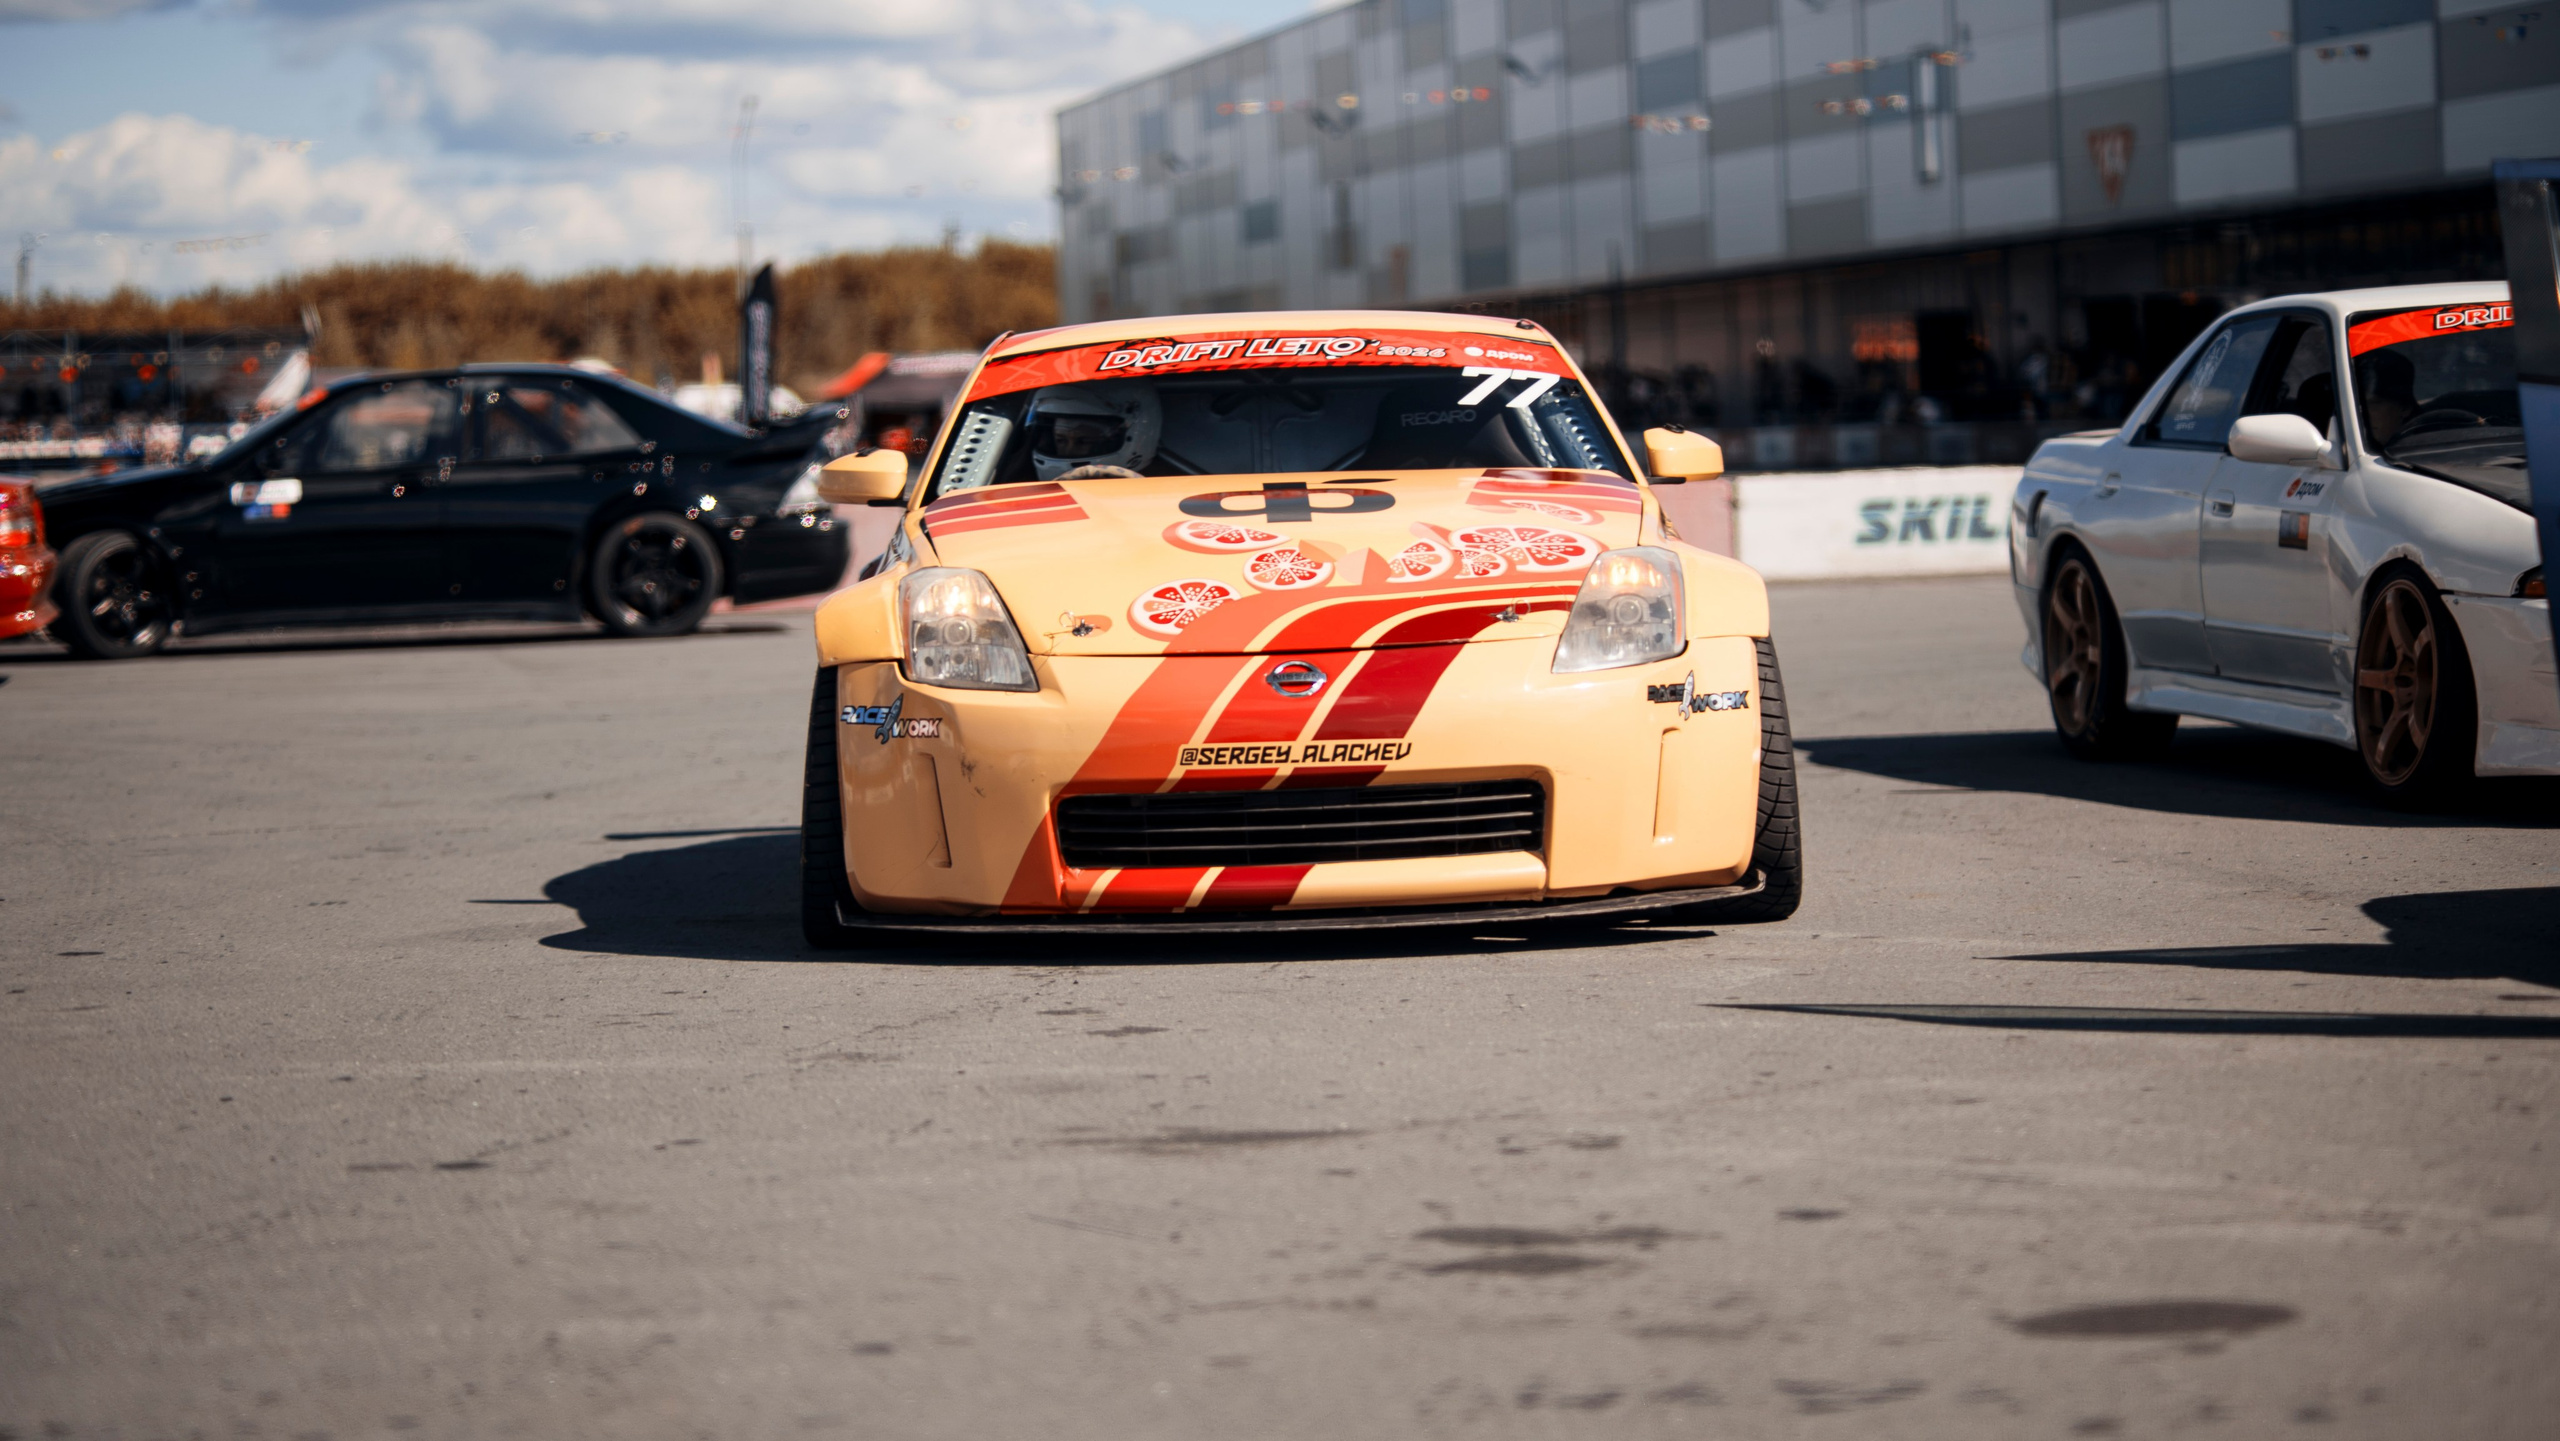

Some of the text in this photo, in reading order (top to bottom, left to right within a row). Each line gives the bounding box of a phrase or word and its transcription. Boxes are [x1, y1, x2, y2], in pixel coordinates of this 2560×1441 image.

[1099, 336, 1446, 370] DRIFT LETO 2026
[1457, 366, 1560, 409] 77
[1401, 409, 1477, 427] RECARO
[1856, 497, 2012, 543] SKIL
[1272, 672, 1321, 682] NISSAN
[1690, 690, 1749, 713] WORK
[840, 706, 942, 739] RACE WORK
[1179, 742, 1412, 766] @SERGEY_ALACHEV
